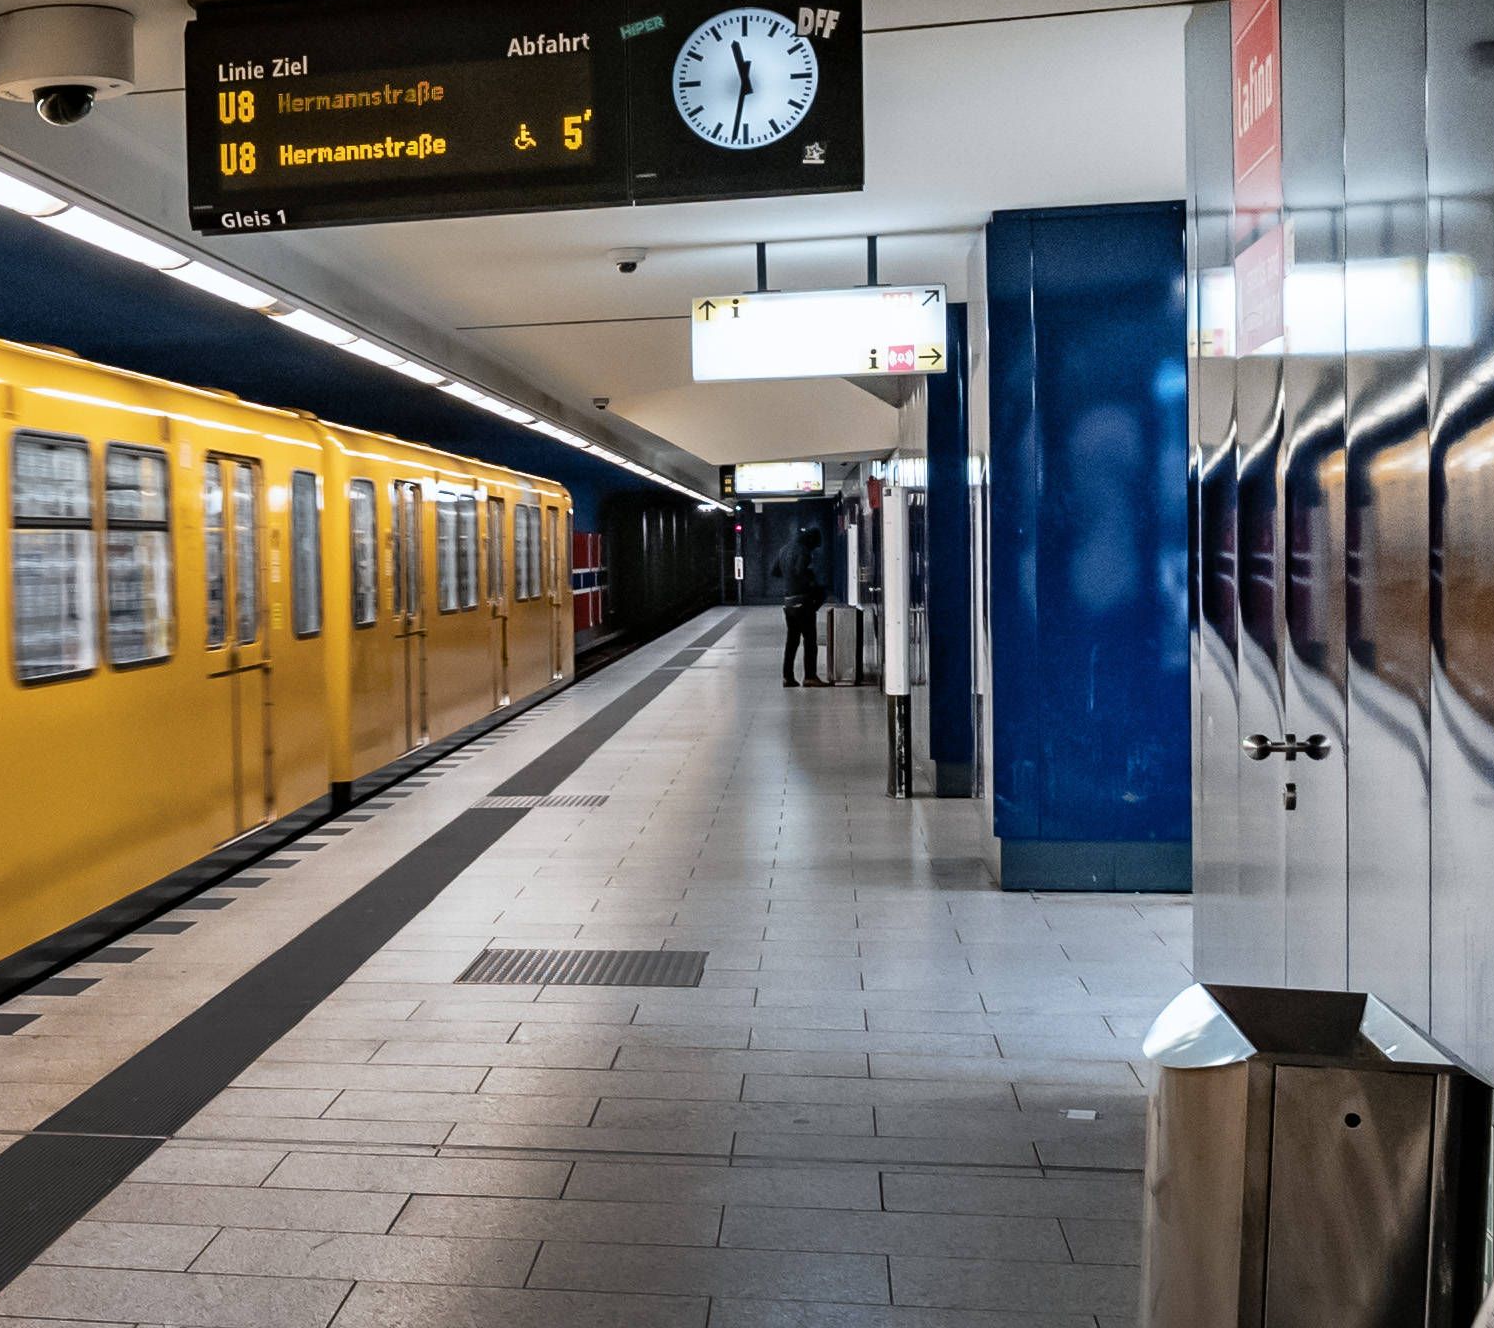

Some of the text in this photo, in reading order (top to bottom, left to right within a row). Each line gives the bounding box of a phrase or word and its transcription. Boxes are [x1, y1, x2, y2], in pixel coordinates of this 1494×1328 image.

[796, 7, 841, 39] DFF
[218, 32, 591, 82] Linie Ziel Abfahrt
[218, 80, 446, 124] U8 Hermannstraße
[220, 141, 257, 176] U8
[279, 132, 447, 167] Hermannstraße
[220, 209, 287, 229] Gleis 1
